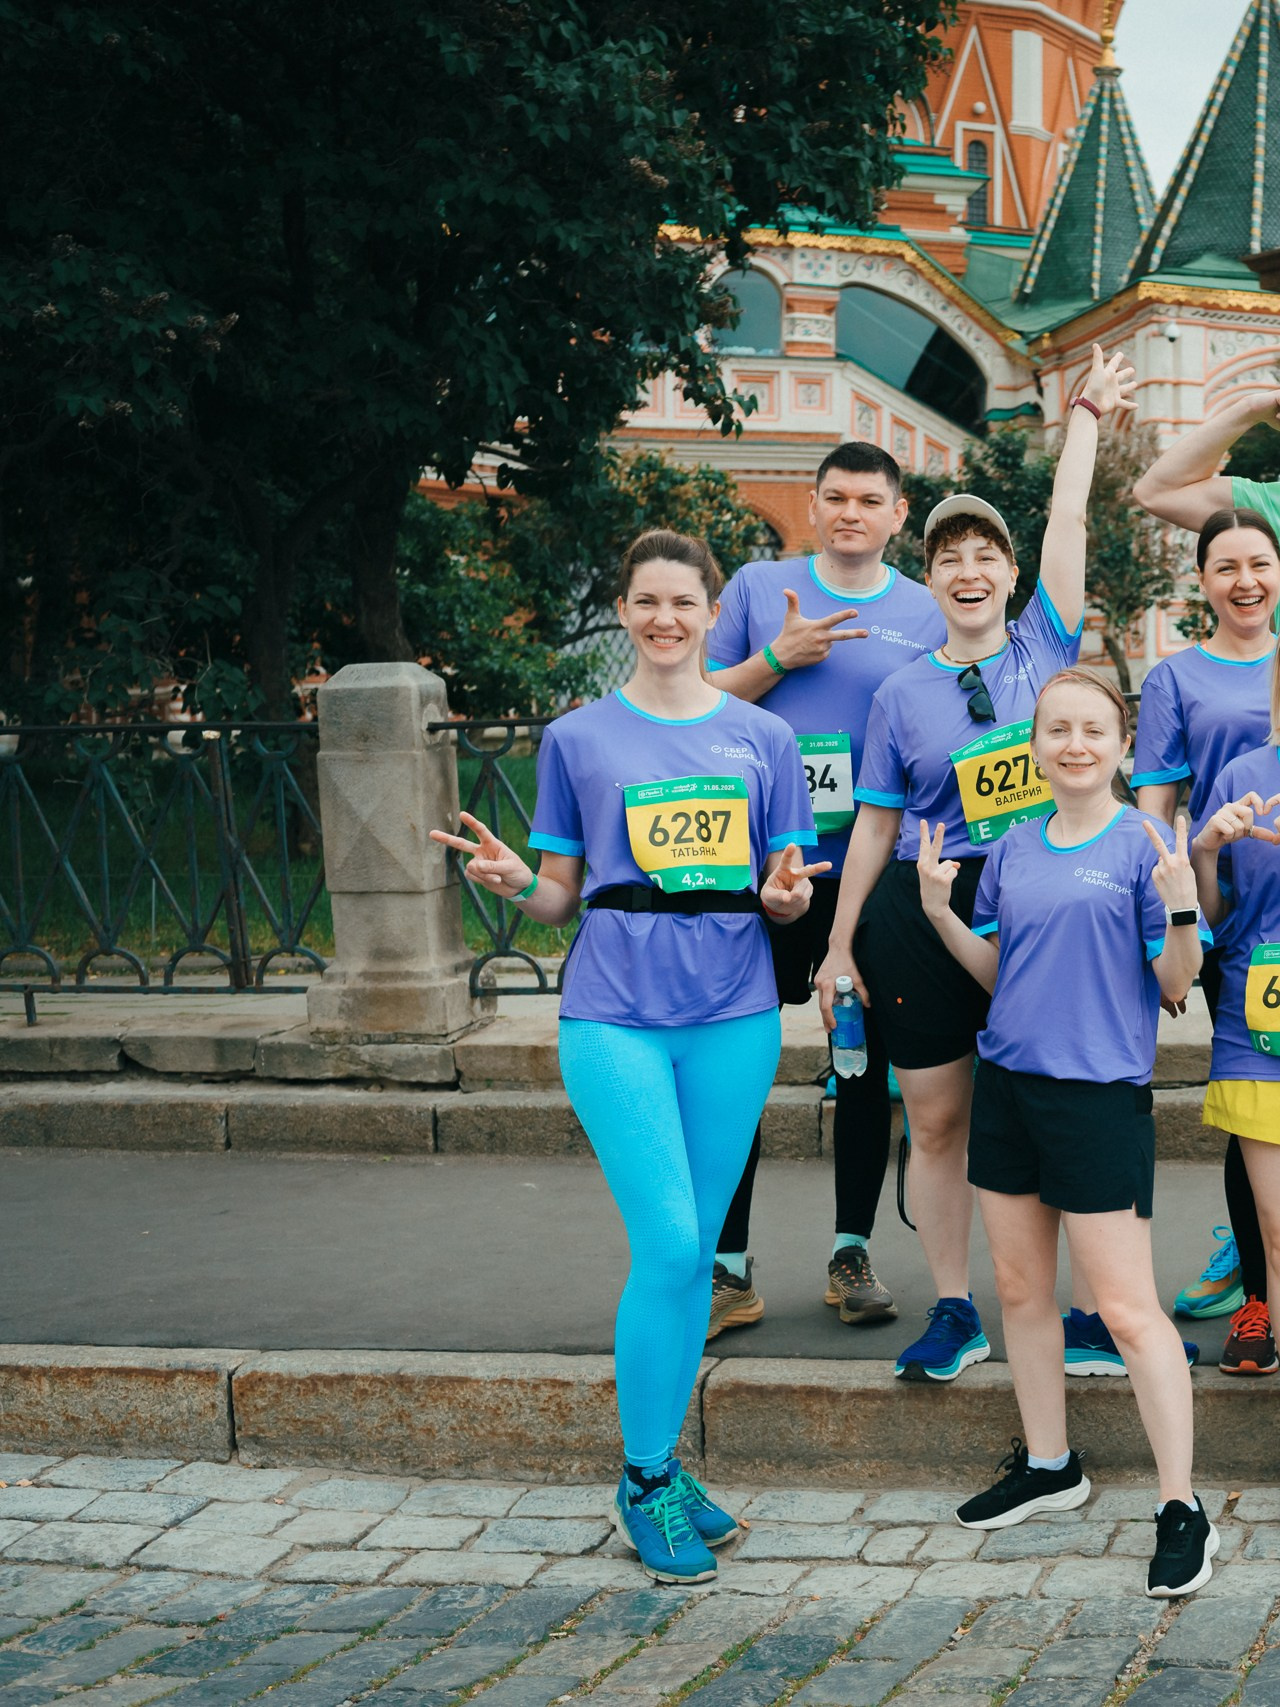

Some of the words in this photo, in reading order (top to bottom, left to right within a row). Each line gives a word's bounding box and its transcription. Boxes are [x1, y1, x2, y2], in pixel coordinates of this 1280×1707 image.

[881, 628, 903, 637] СБЕР
[881, 634, 927, 651] МАРКЕТИНГ
[995, 785, 1042, 807] ВАЛЕРИЯ
[648, 810, 732, 847] 6287
[977, 820, 993, 840] E
[670, 846, 717, 858] ТАТЬЯНА
[1085, 869, 1110, 879] СБЕР
